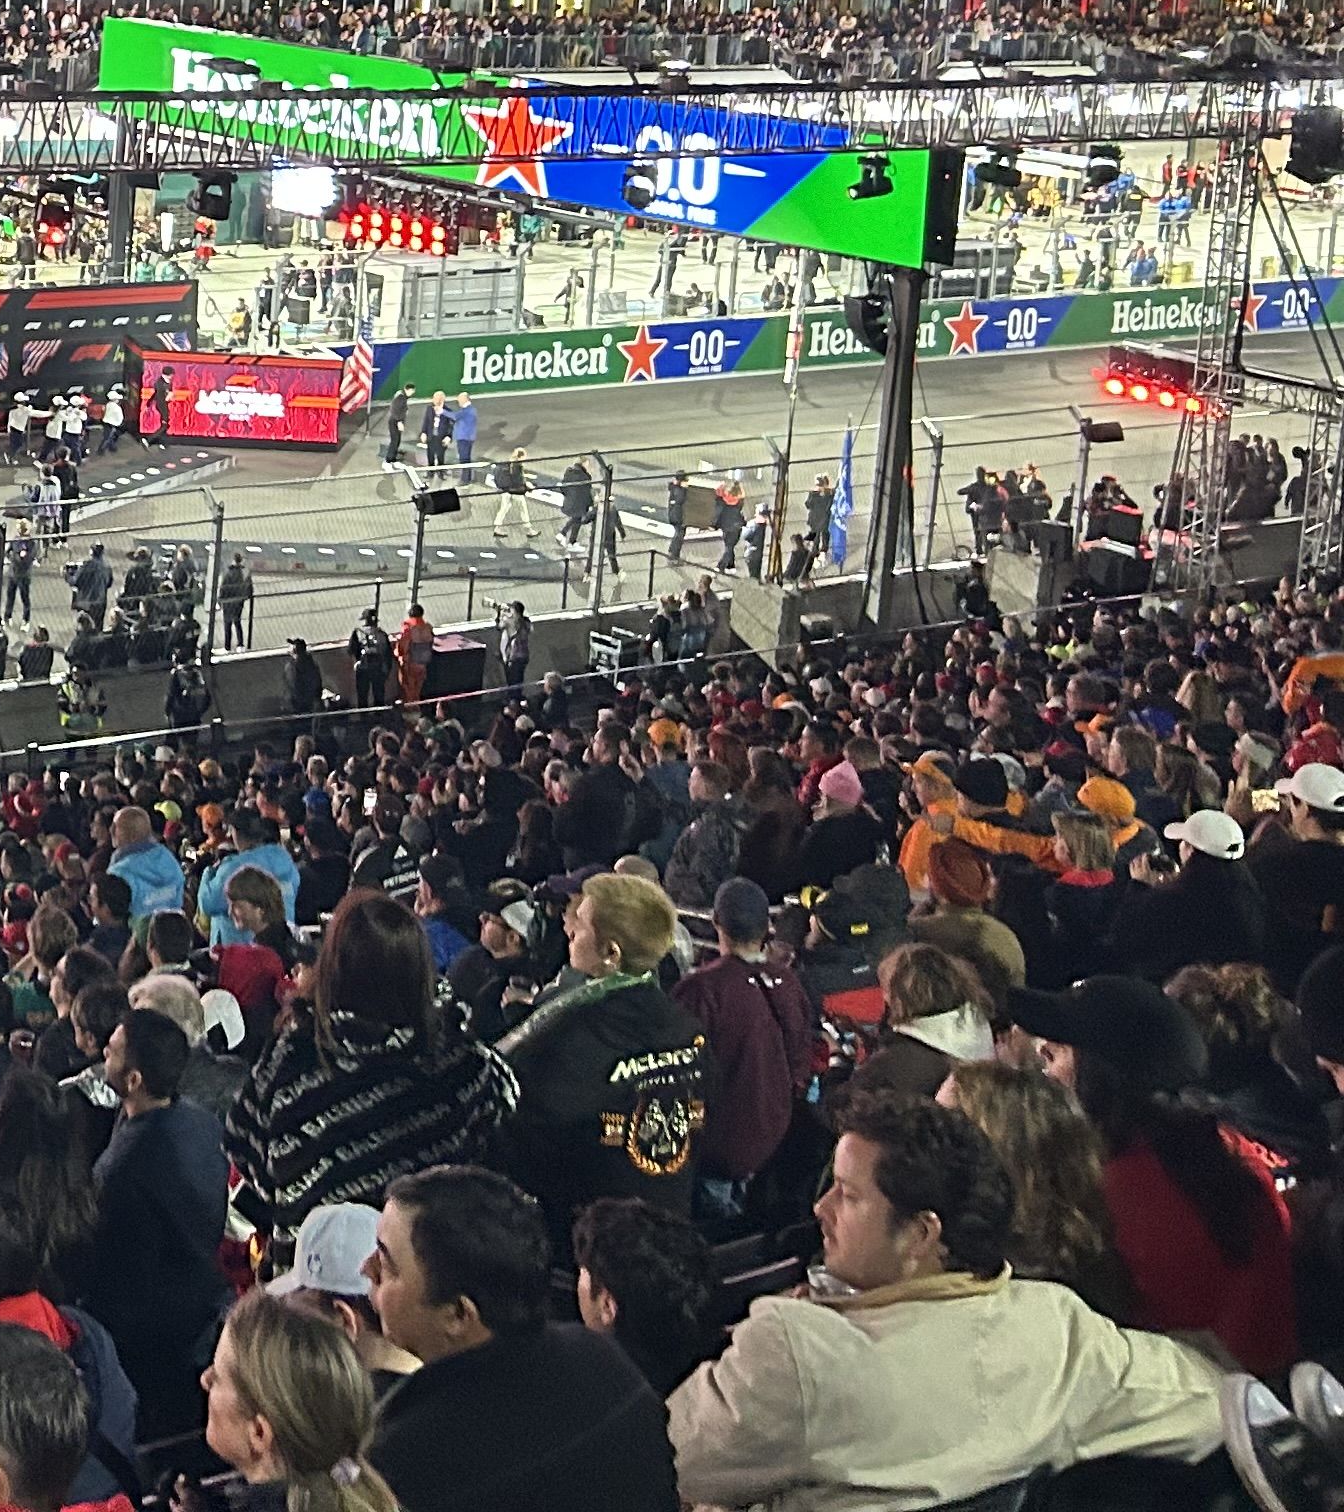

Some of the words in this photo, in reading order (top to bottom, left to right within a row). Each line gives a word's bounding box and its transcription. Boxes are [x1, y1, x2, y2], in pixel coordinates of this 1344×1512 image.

[1008, 307, 1036, 340] 0.0
[461, 345, 610, 384] Heineken
[689, 331, 725, 367] 0.0
